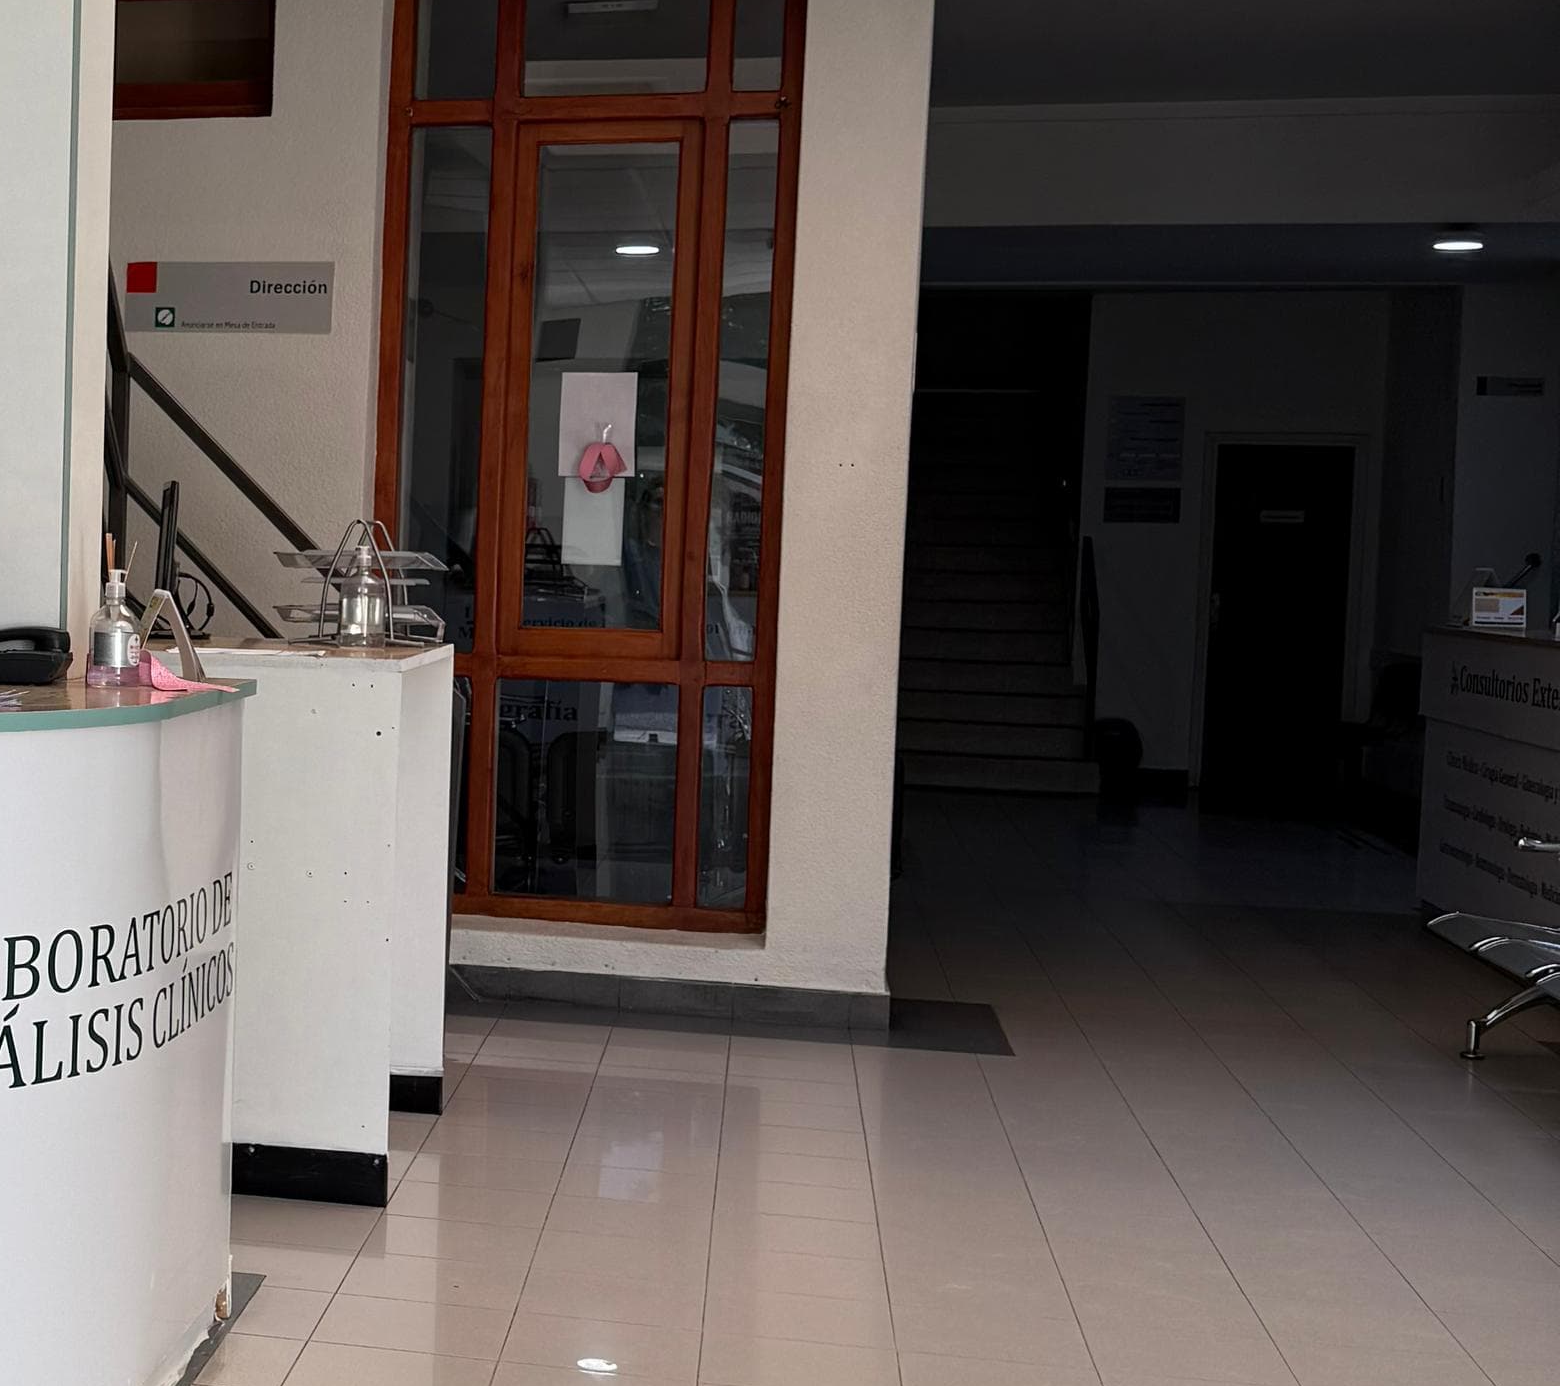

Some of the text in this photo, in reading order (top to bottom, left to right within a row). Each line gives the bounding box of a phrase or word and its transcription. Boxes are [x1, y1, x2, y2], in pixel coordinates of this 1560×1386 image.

[249, 279, 328, 294] Dirección
[522, 617, 575, 628] ervicio
[1460, 665, 1560, 711] Consultorios Exte
[500, 699, 578, 724] grafía
[212, 871, 233, 936] DE
[152, 941, 235, 1049] CLÍNICOS
